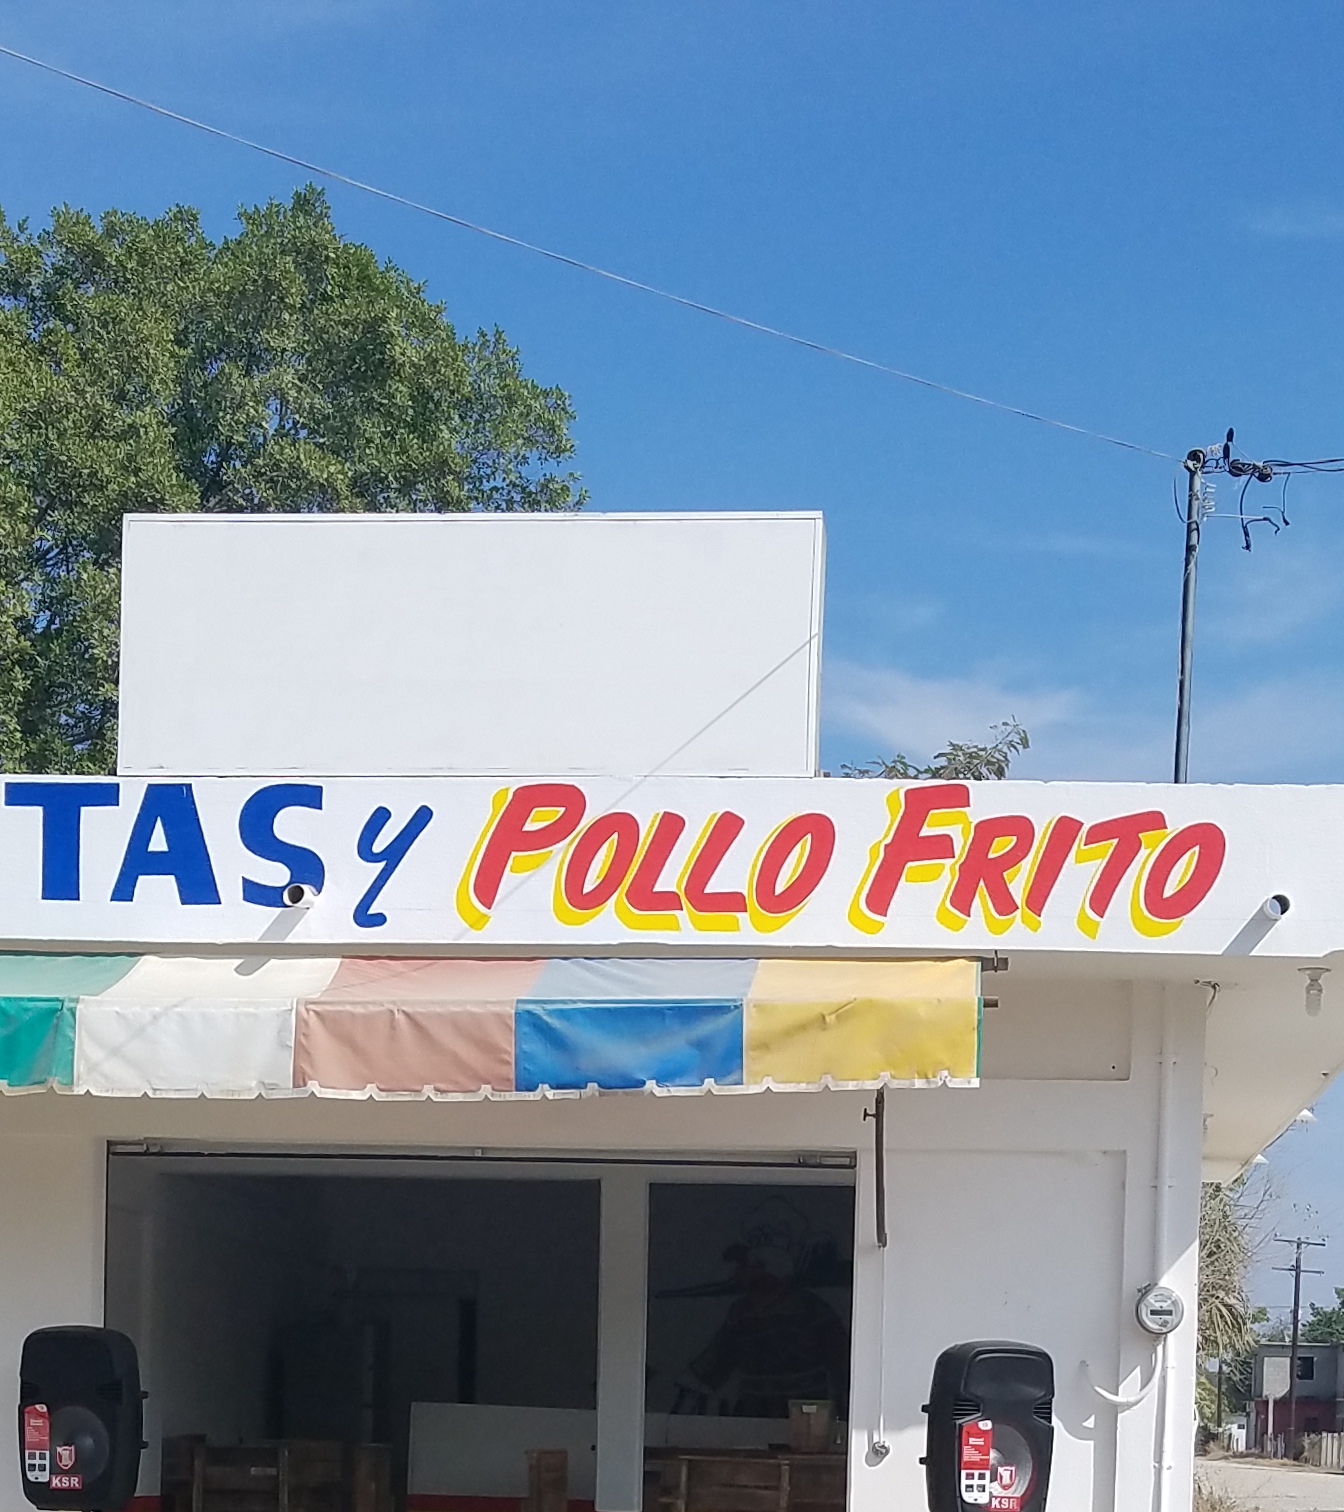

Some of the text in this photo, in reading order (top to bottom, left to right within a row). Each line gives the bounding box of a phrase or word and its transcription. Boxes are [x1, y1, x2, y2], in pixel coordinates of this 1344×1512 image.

[456, 782, 1226, 940] POLLO FRITO
[52, 1476, 80, 1487] KSR
[991, 1497, 1017, 1509] KSR
